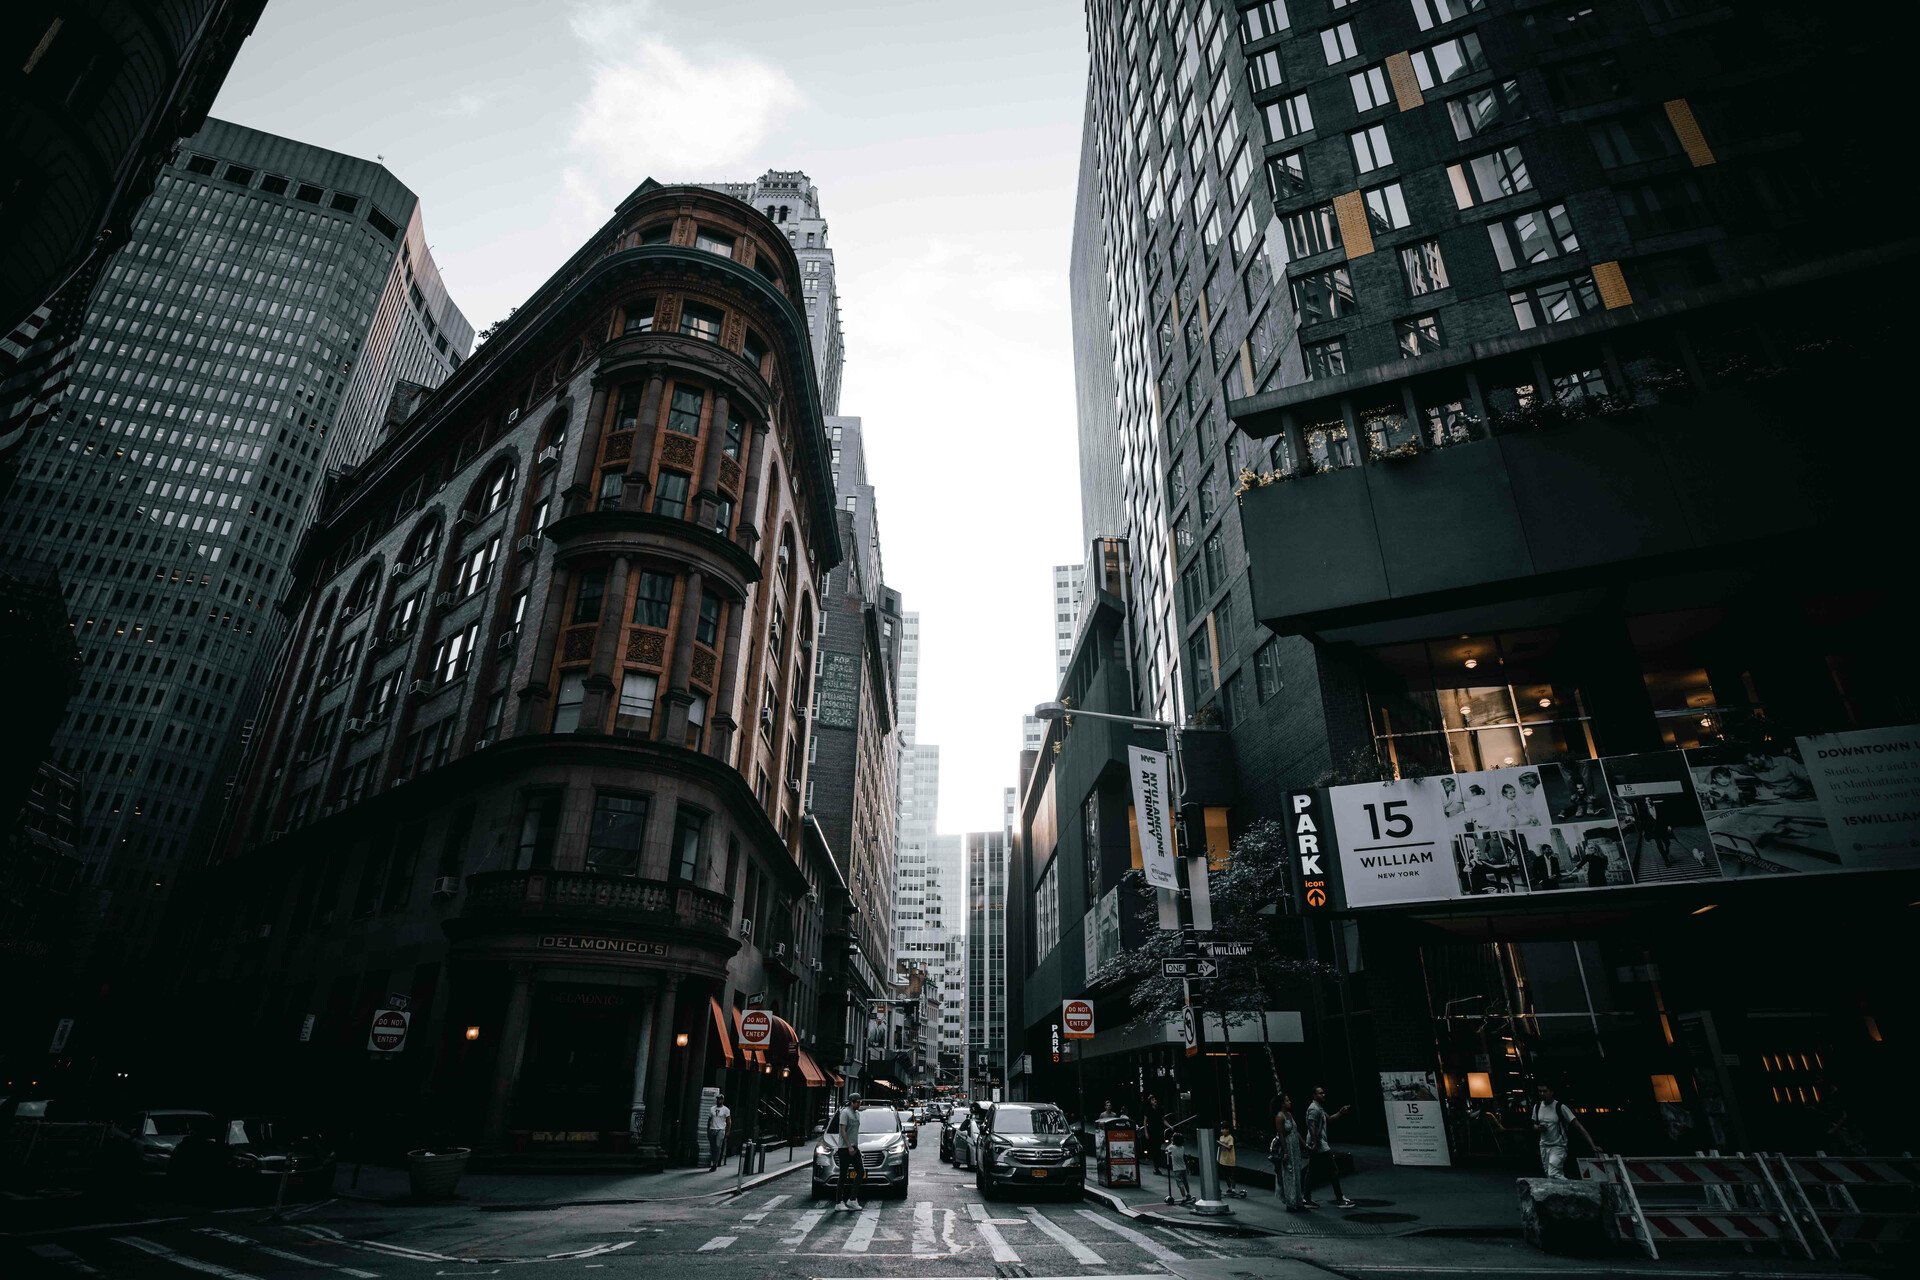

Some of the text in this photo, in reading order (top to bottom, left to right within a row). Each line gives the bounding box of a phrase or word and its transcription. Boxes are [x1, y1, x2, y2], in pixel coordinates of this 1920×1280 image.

[1817, 741, 1910, 759] DOWNTOWN
[1141, 770, 1157, 838] AT TRINITY
[1149, 772, 1165, 858] NYU LANGONE
[1362, 800, 1413, 840] 15
[1292, 794, 1323, 876] PARK
[1360, 851, 1433, 868] WILLIAM
[1398, 870, 1420, 878] YORK
[1305, 879, 1325, 888] icon
[543, 936, 665, 956] DELMONICO'S
[1214, 945, 1247, 956] WILLIAM
[1167, 964, 1184, 972] ONE
[378, 1018, 388, 1026] DO
[377, 1035, 398, 1044] ENTER
[1051, 1024, 1060, 1054] PARK
[1406, 1103, 1419, 1114] 15
